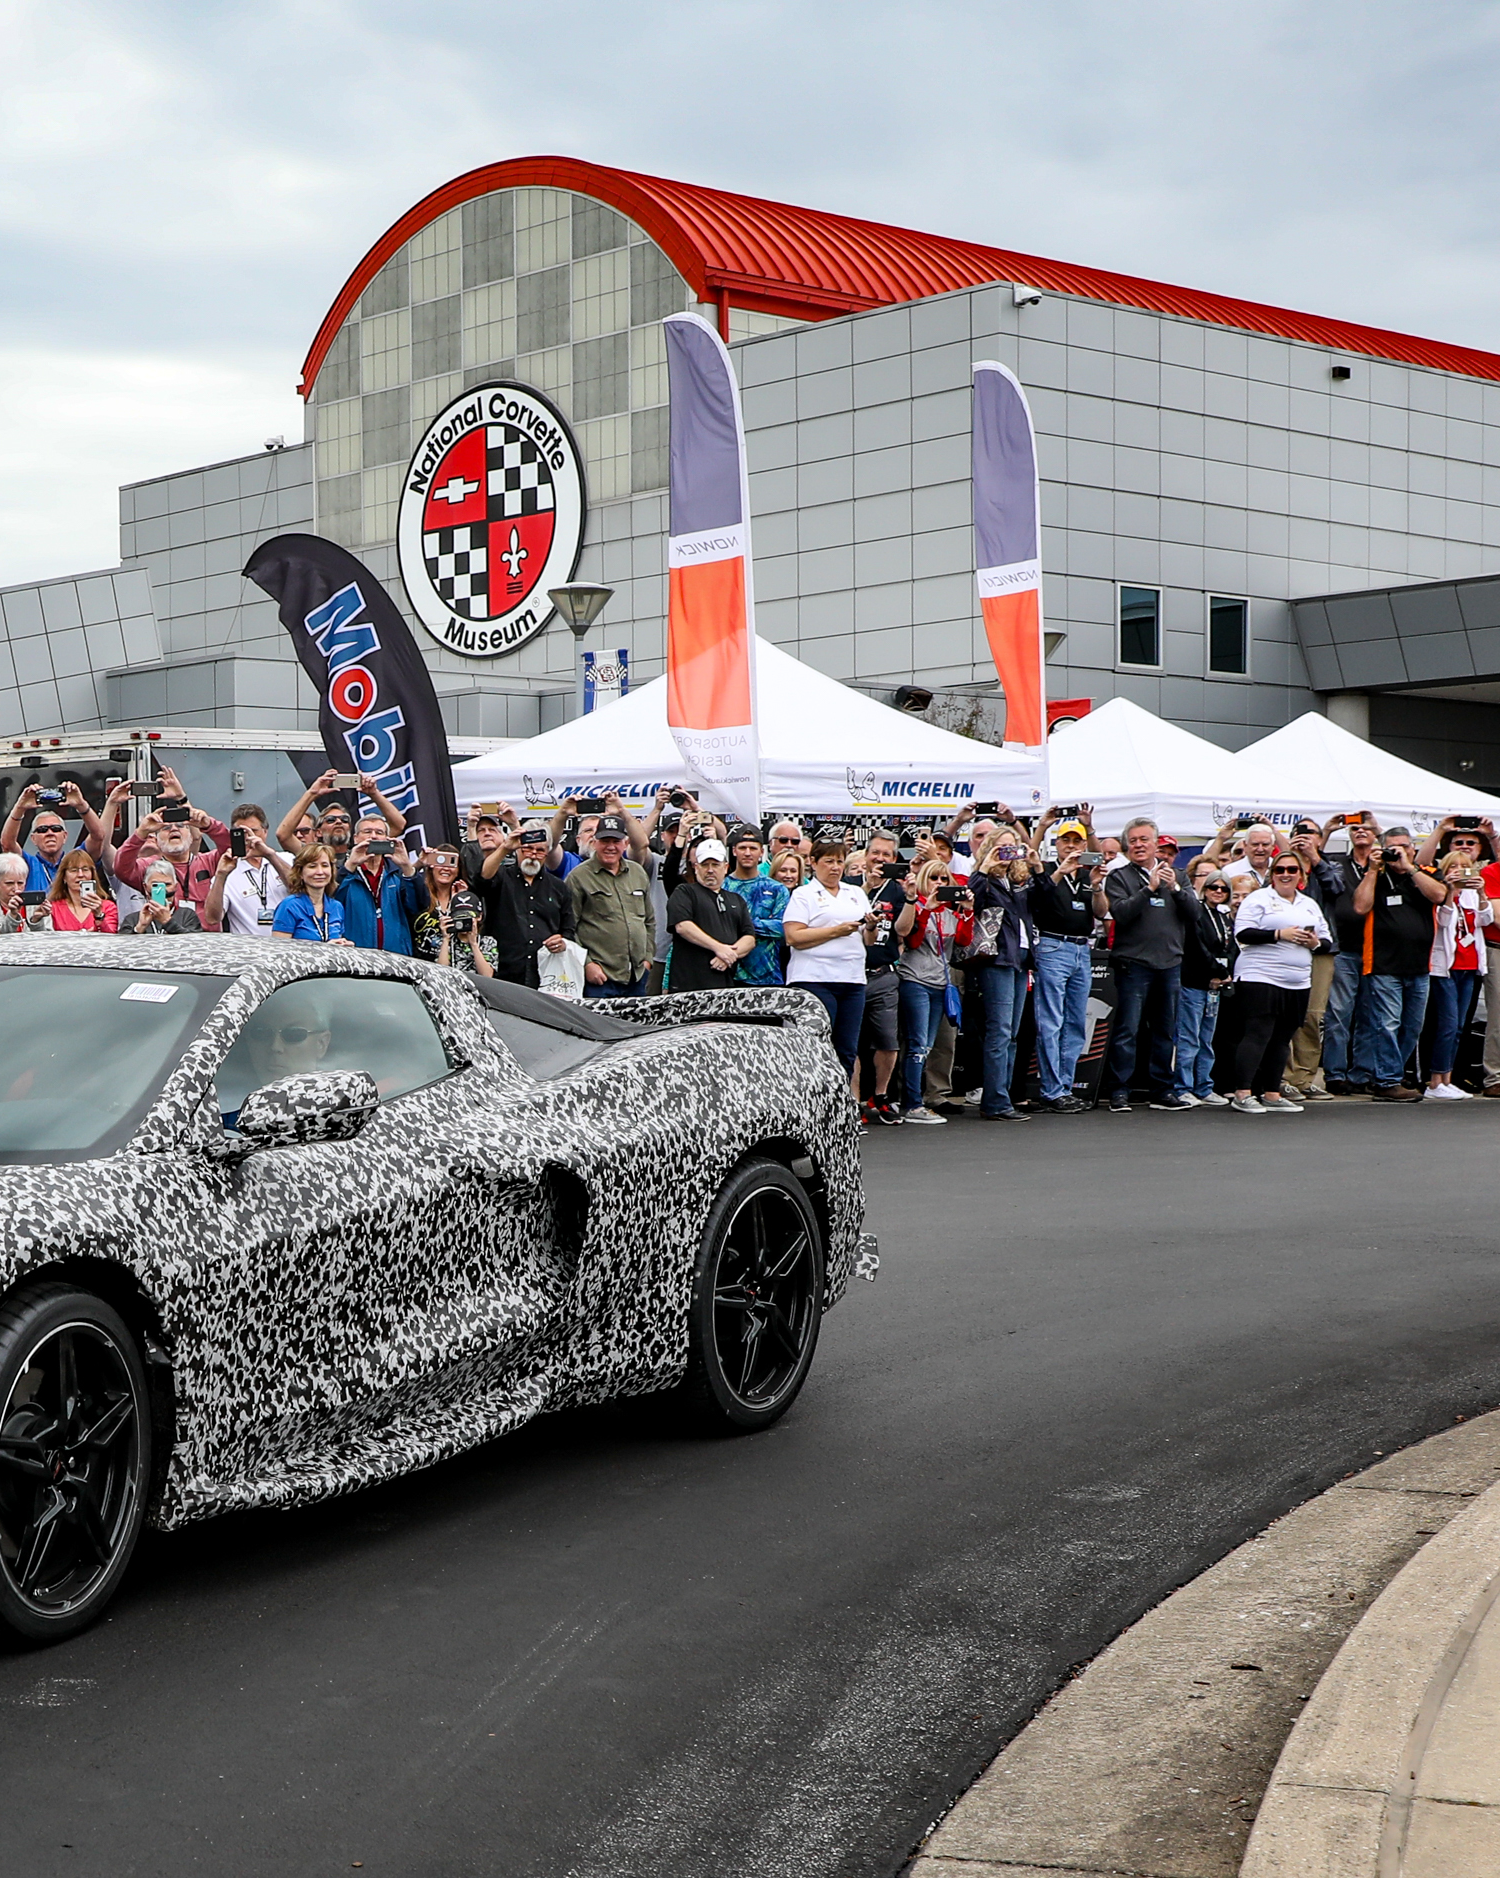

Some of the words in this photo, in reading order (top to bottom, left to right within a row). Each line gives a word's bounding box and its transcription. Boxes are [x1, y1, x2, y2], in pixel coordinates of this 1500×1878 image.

[409, 396, 483, 496] National
[488, 393, 565, 472] Corvette
[443, 608, 537, 651] Museum
[303, 581, 421, 819] Mobil
[882, 781, 976, 798] MICHELIN
[1238, 812, 1303, 826] MHELIN
